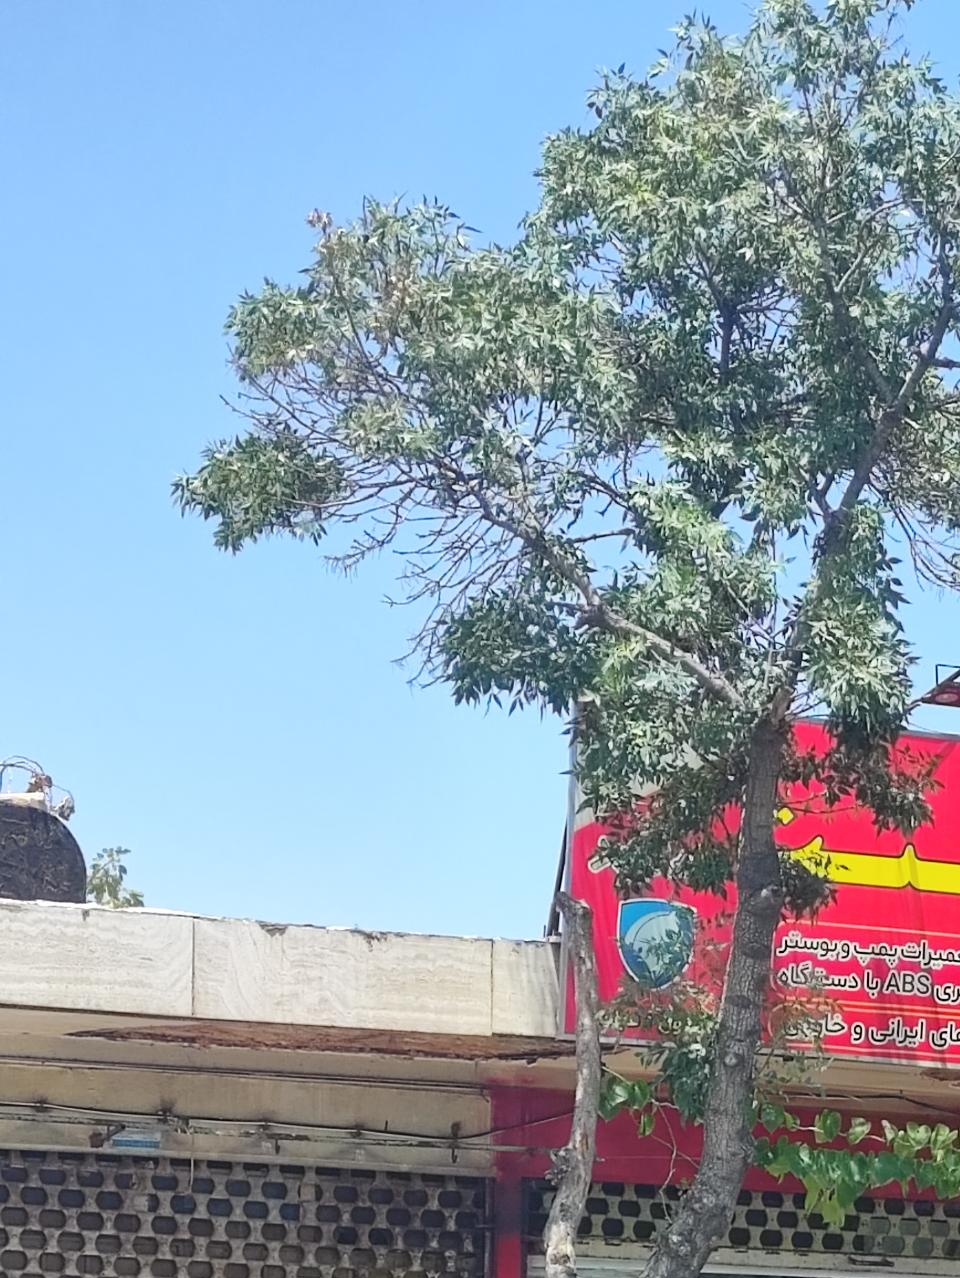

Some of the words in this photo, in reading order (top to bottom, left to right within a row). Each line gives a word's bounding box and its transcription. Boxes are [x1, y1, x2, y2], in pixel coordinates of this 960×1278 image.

[778, 934, 838, 959] بوستر
[854, 943, 897, 966] پمپ
[865, 970, 880, 997] با
[885, 972, 931, 994] ABS
[870, 1019, 924, 1043] ایرانی
